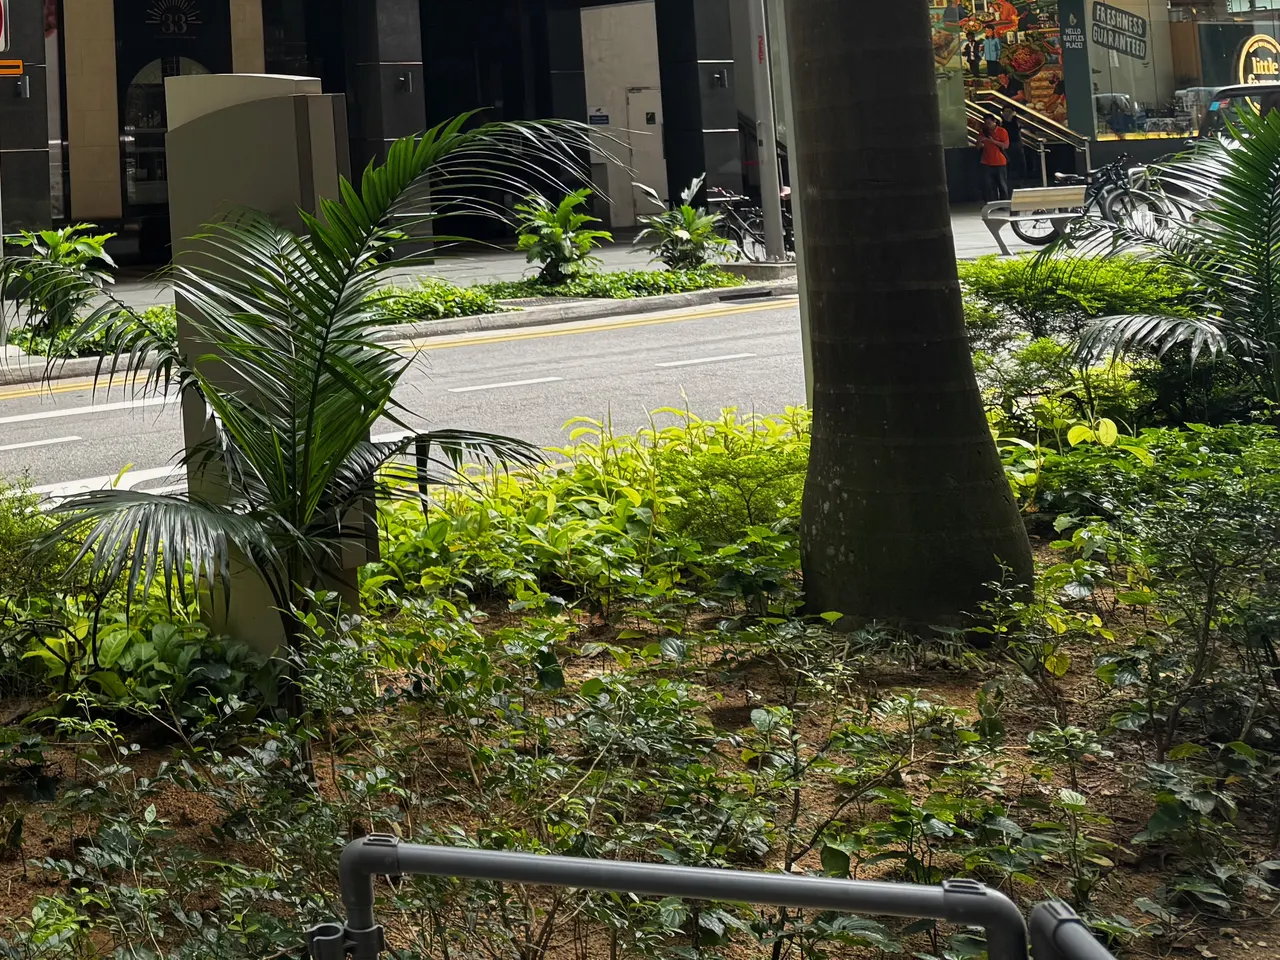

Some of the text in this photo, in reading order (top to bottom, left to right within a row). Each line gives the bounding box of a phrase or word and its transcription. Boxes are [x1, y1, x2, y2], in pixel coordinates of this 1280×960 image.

[1096, 5, 1143, 35] FRESHNESS
[1093, 26, 1145, 57] GUARANTEED
[1251, 56, 1279, 74] little
